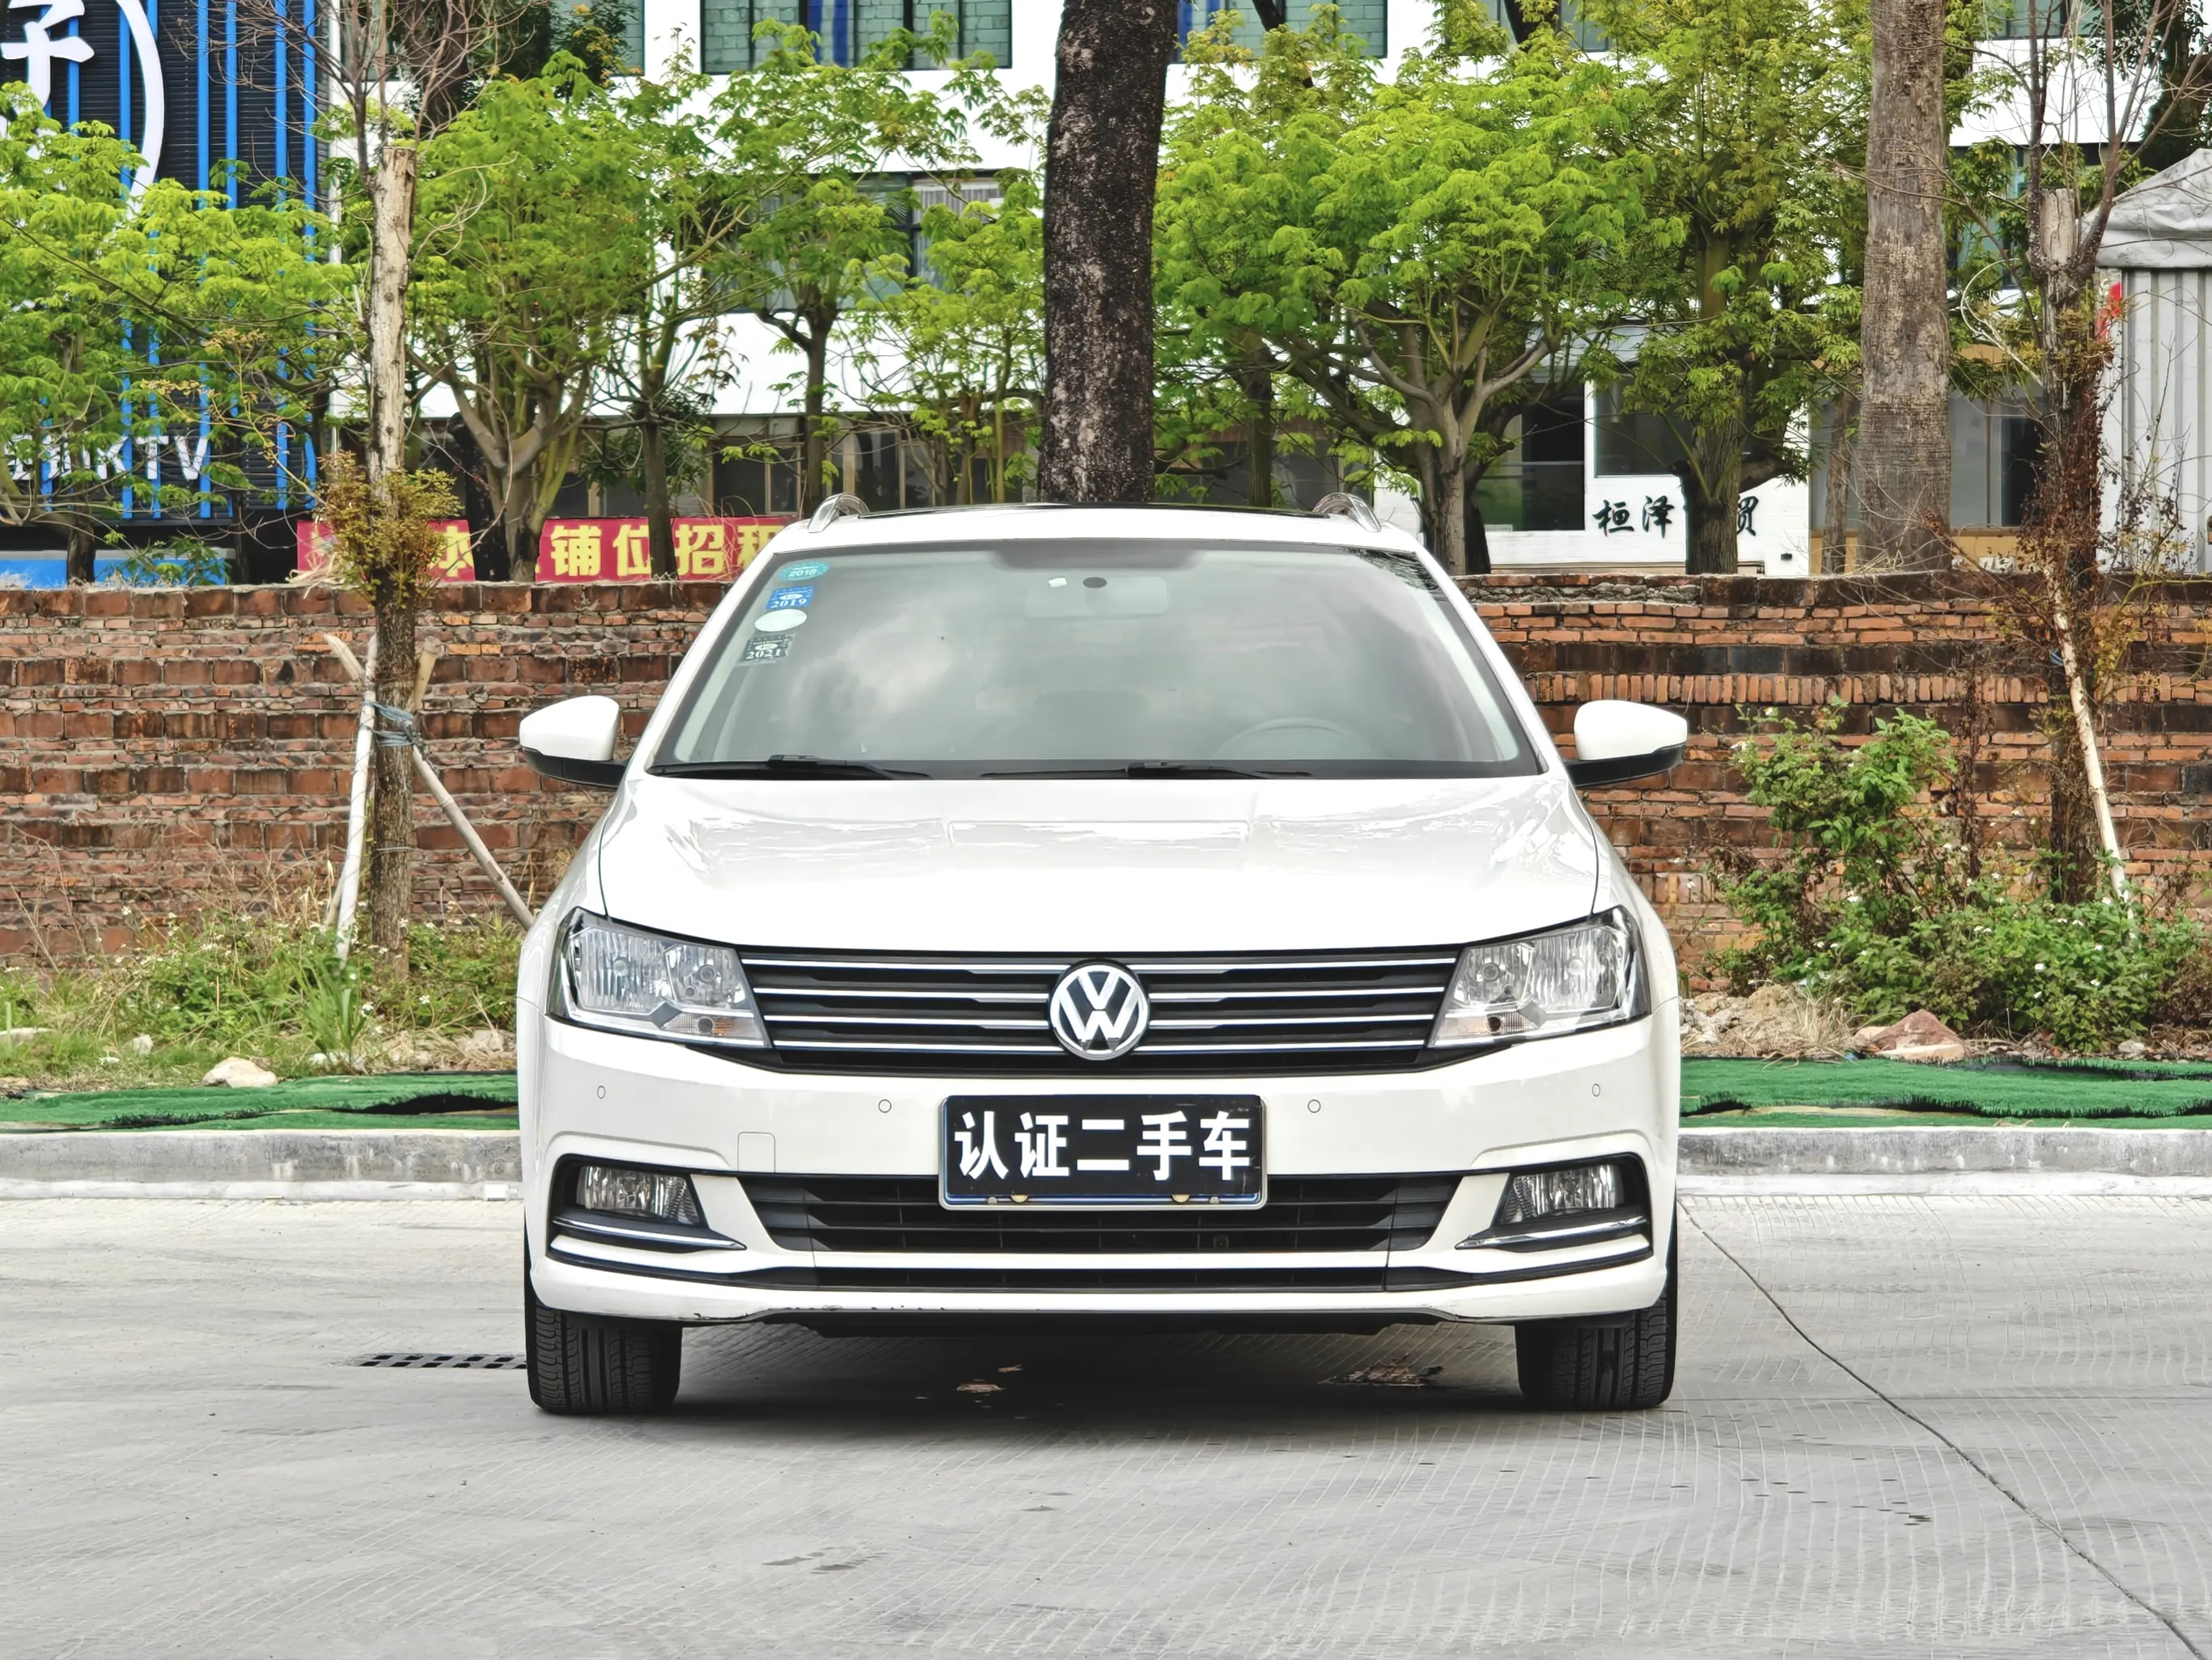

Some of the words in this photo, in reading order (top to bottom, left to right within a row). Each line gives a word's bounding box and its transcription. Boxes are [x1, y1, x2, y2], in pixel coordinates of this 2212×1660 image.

[1591, 494, 1760, 539] 桓泽贸
[788, 568, 818, 578] 2018
[770, 598, 807, 608] 2019
[744, 648, 782, 659] 2021
[953, 1110, 1251, 1181] 认证二手车
